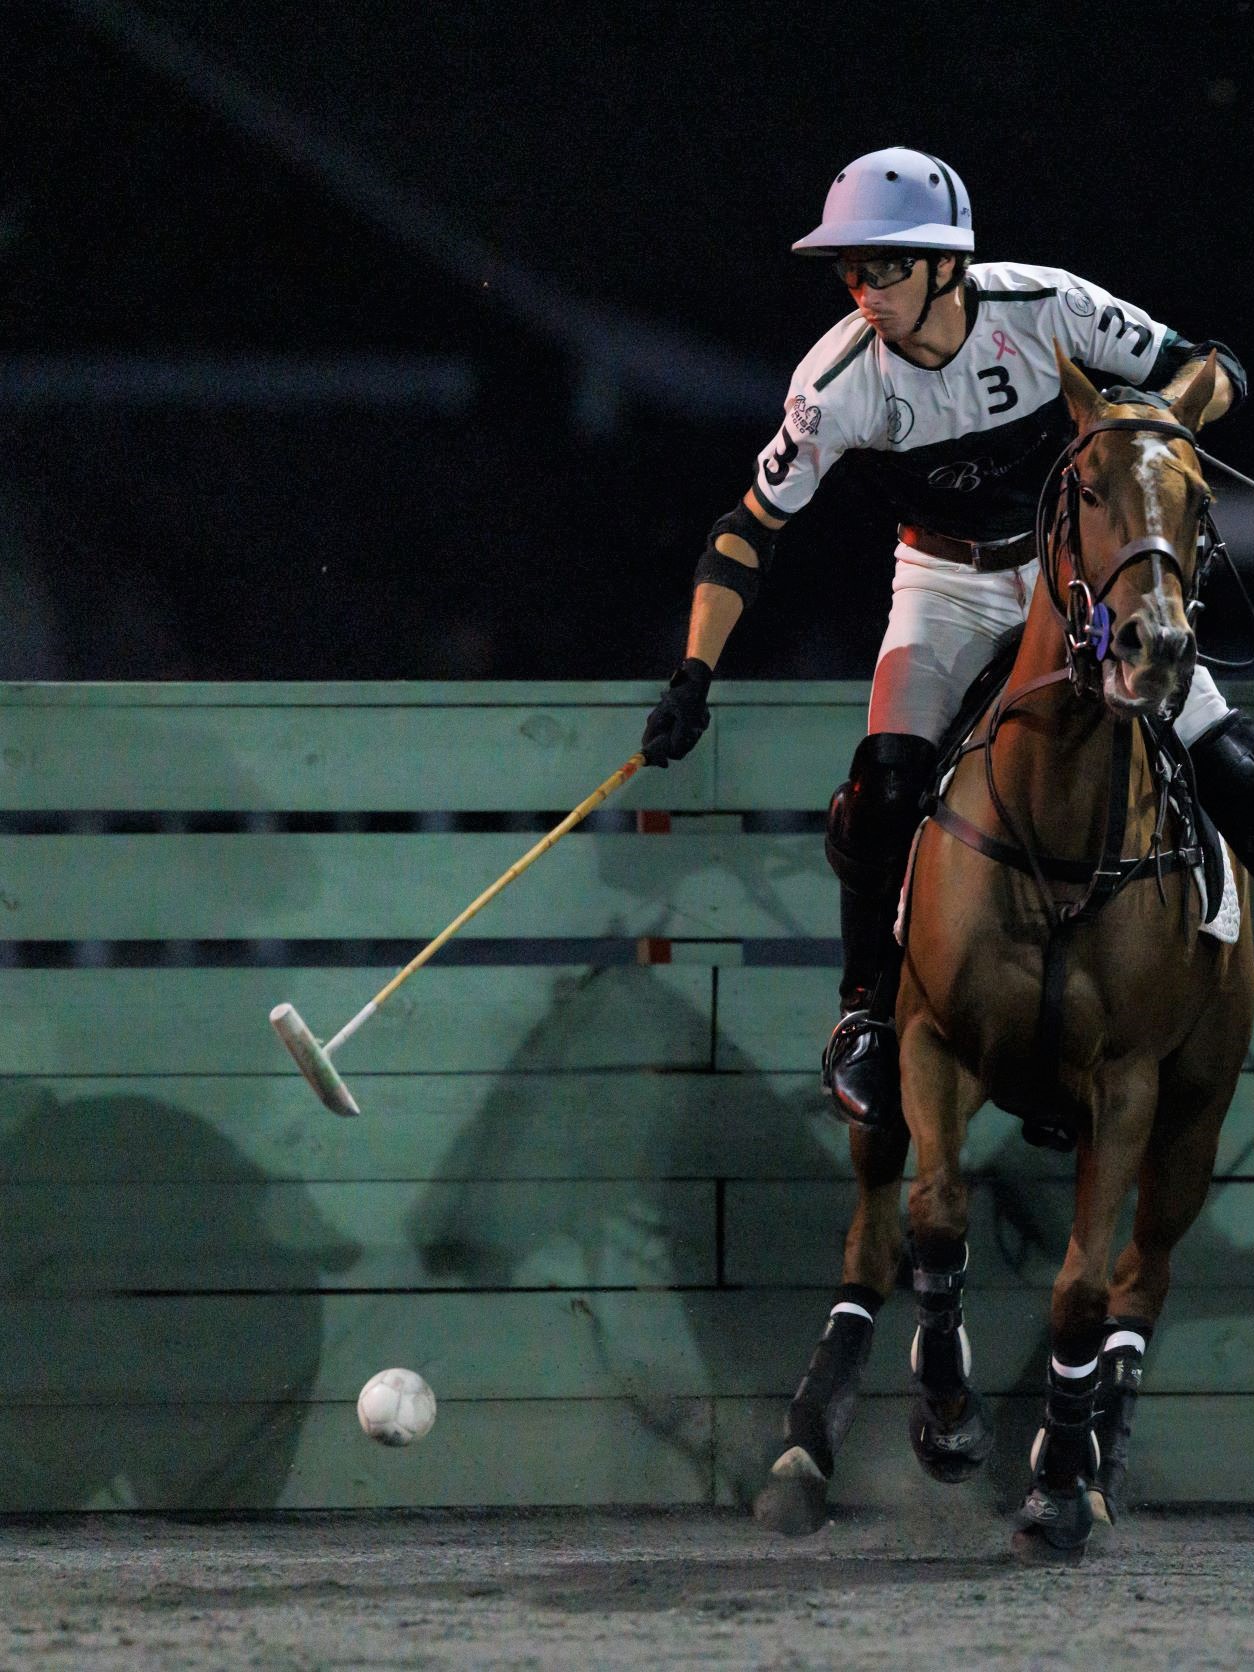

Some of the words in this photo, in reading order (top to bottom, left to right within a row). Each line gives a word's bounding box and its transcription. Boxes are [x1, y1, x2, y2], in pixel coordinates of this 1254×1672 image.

[1097, 305, 1153, 358] 3
[976, 365, 1019, 415] 3
[762, 424, 799, 487] 3
